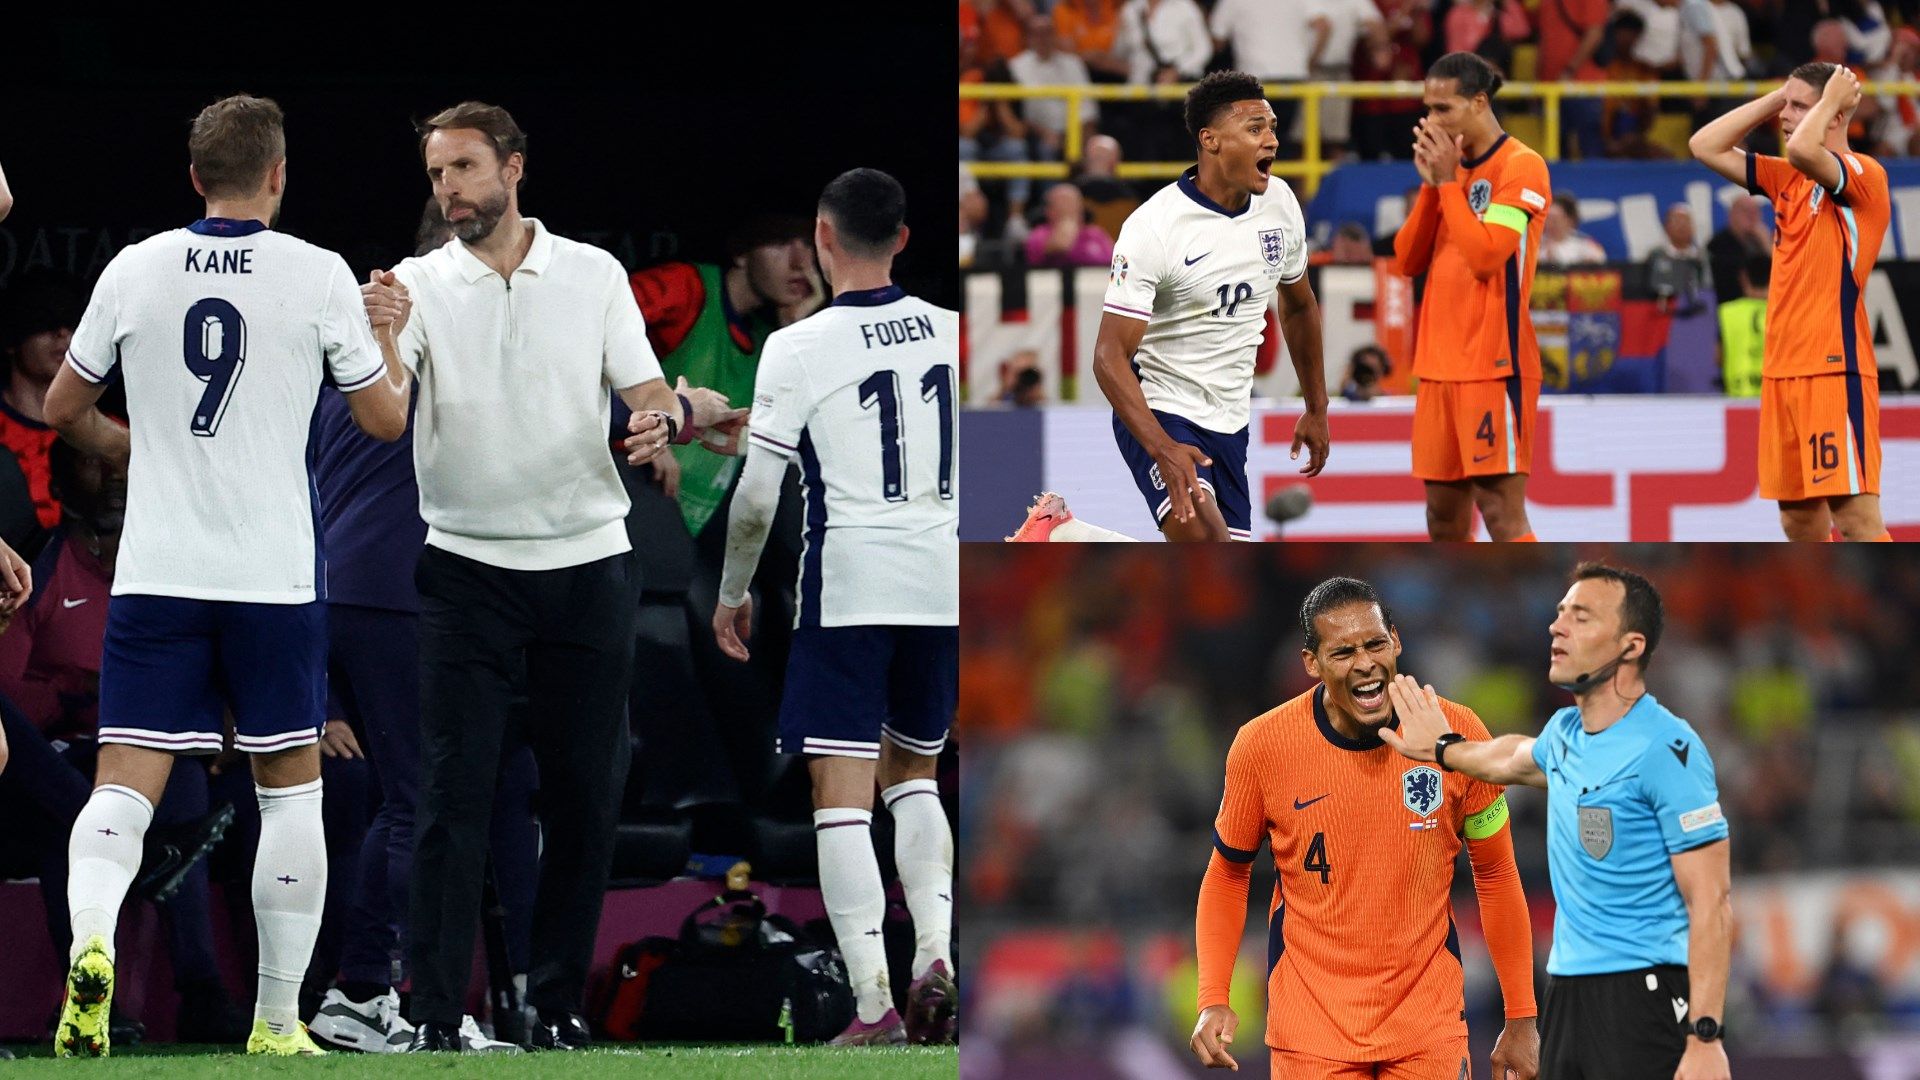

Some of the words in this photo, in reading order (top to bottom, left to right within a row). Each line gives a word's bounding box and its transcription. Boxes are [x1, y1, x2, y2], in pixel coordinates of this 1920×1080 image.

[185, 247, 254, 274] KANE
[860, 314, 935, 349] FODEN
[183, 297, 247, 437] 9
[858, 364, 957, 503] 11
[1475, 410, 1496, 447] 4
[1808, 432, 1839, 470] 16
[1303, 831, 1331, 884] 4
